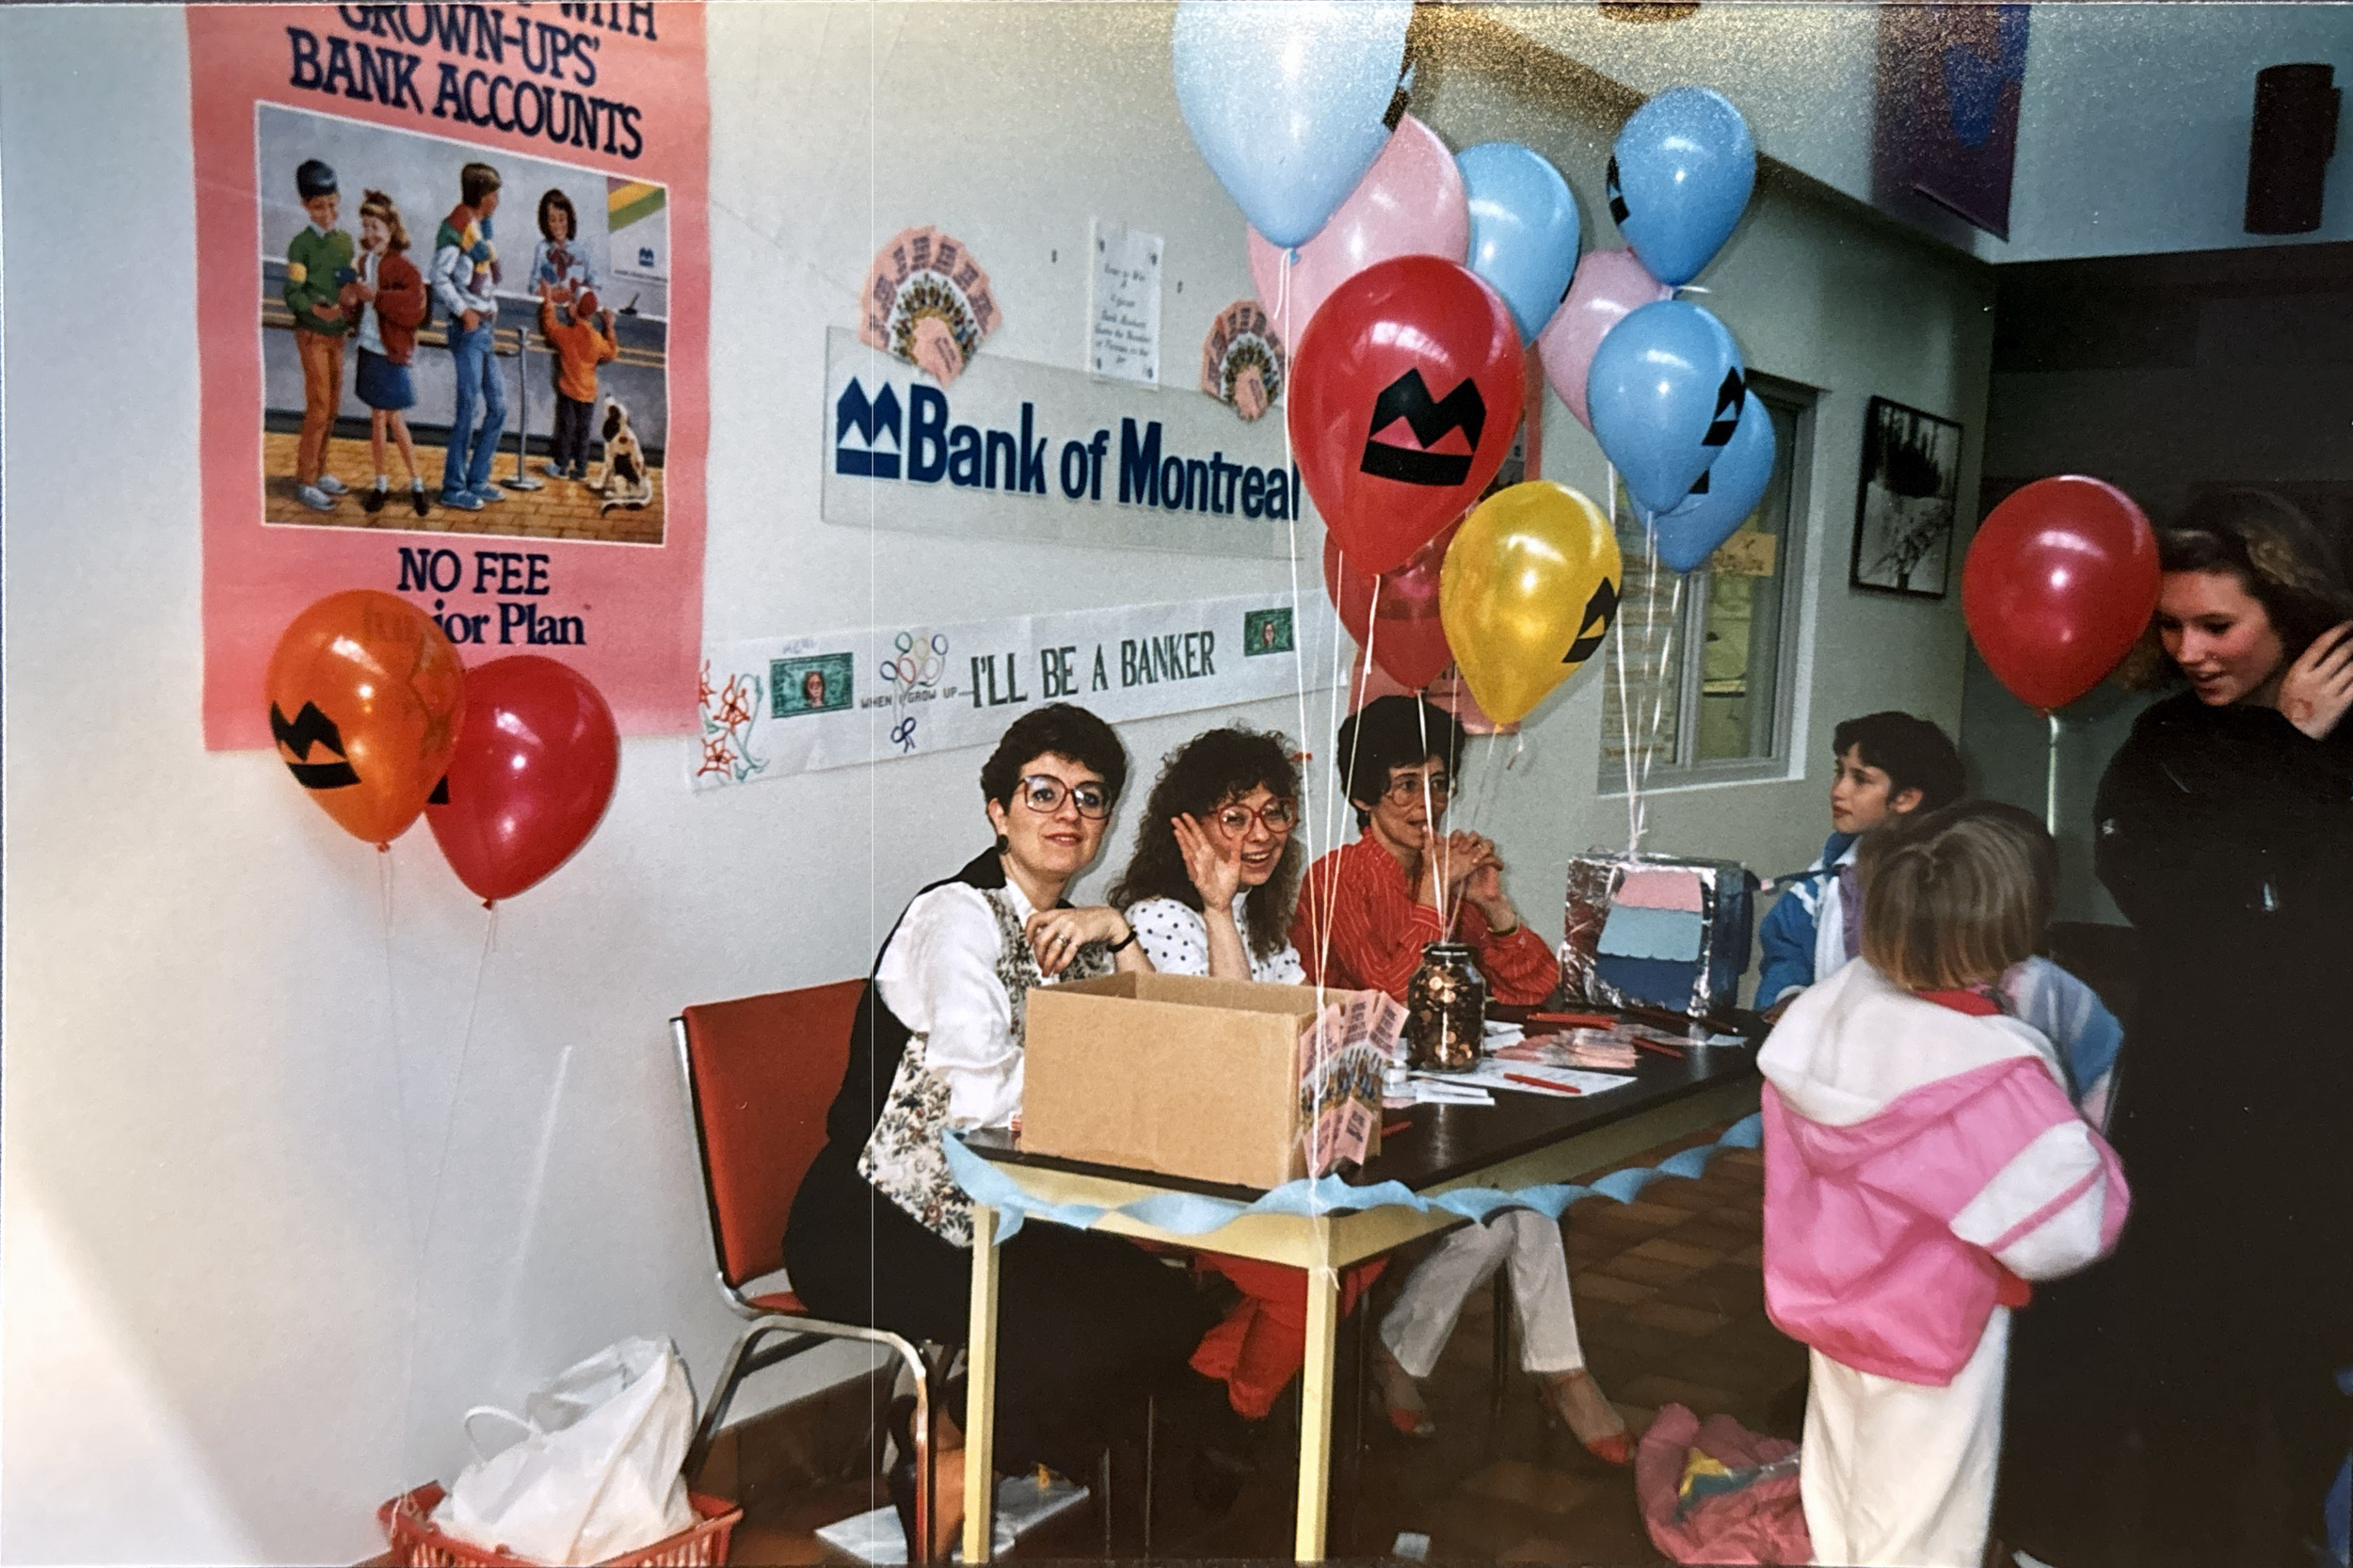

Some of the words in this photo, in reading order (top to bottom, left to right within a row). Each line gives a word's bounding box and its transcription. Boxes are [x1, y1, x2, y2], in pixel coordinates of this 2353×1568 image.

[337, 4, 600, 87] GROWN-UPS'
[285, 25, 424, 114] BANK
[432, 61, 644, 160] ACCOUNTS
[907, 382, 1047, 494] Bank
[1061, 429, 1110, 501] of
[1118, 417, 1299, 520] Montreal
[397, 547, 461, 593] NO
[473, 551, 550, 595] FEE
[497, 602, 586, 646] Plan
[860, 695, 892, 710] WHEN
[907, 690, 936, 704] GROW
[970, 652, 1028, 709] I'LL
[1040, 646, 1080, 699] BE
[1092, 643, 1109, 693] A
[1121, 630, 1217, 689] BANKER
